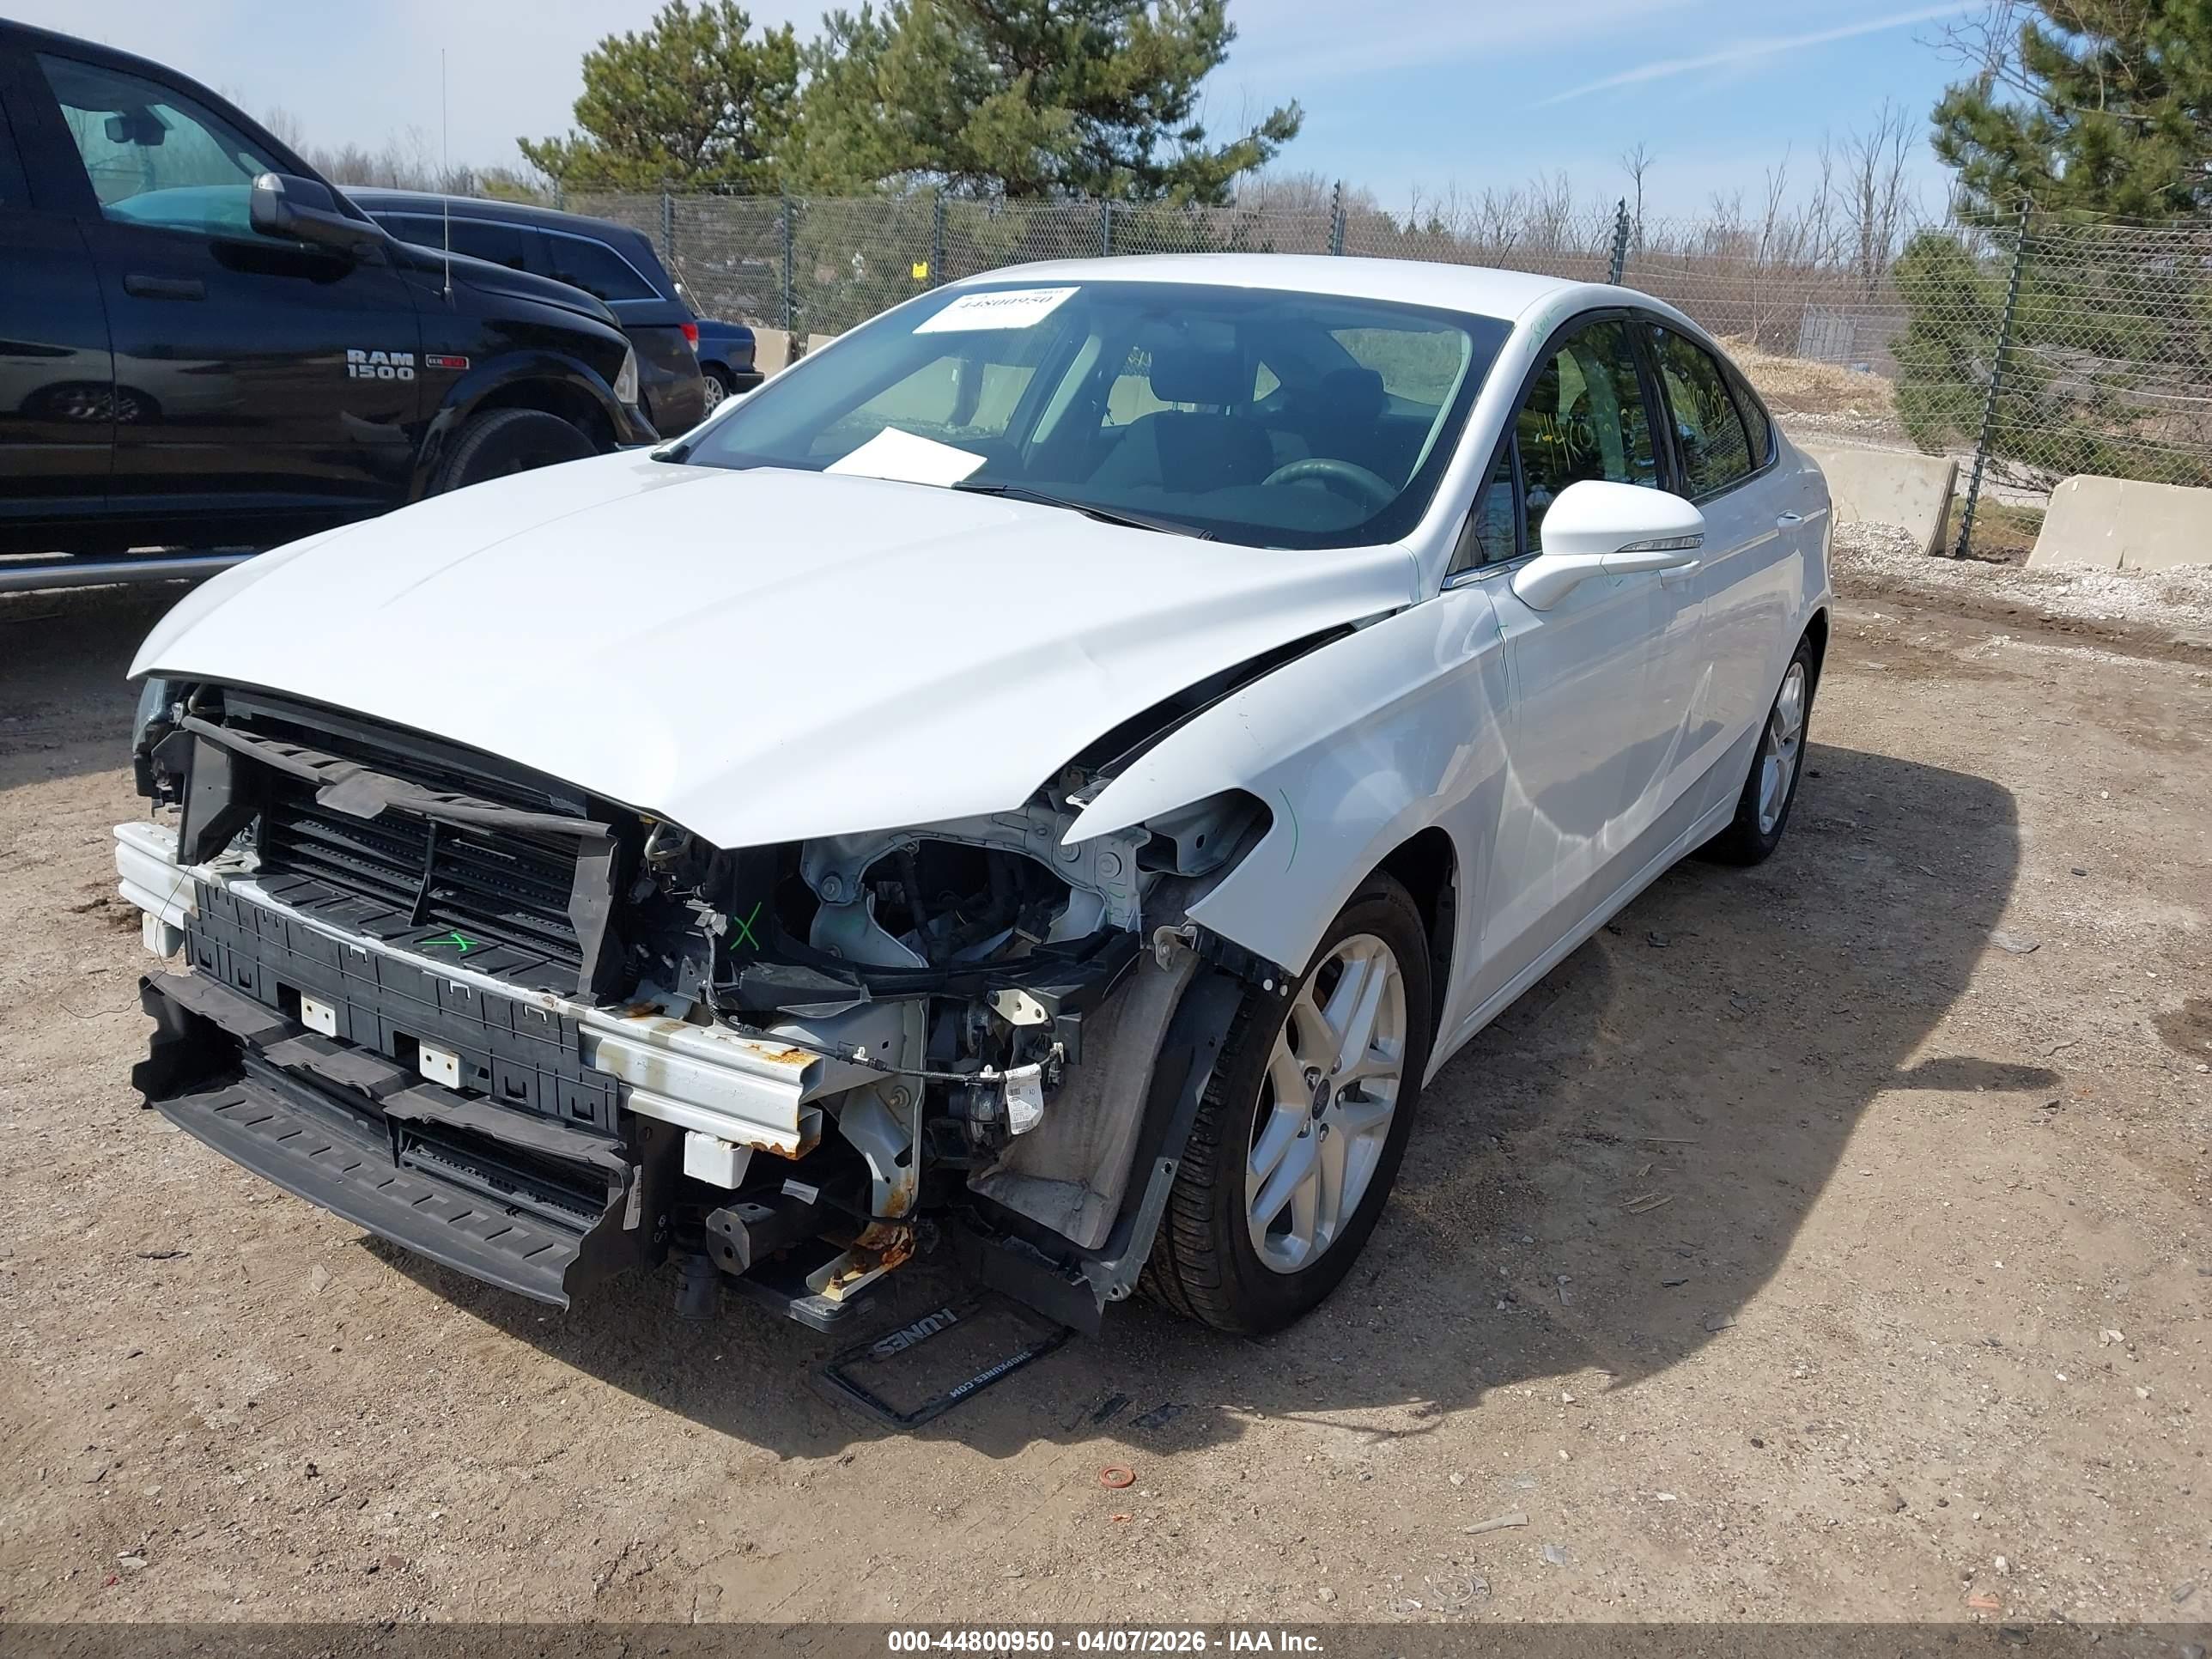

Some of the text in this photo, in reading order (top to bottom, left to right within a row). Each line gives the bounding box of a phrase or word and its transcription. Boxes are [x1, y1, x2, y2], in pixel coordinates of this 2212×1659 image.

[347, 349, 415, 366] RAM
[348, 364, 415, 380] 1500
[950, 1351, 1032, 1399] SHOPKUNES.COM
